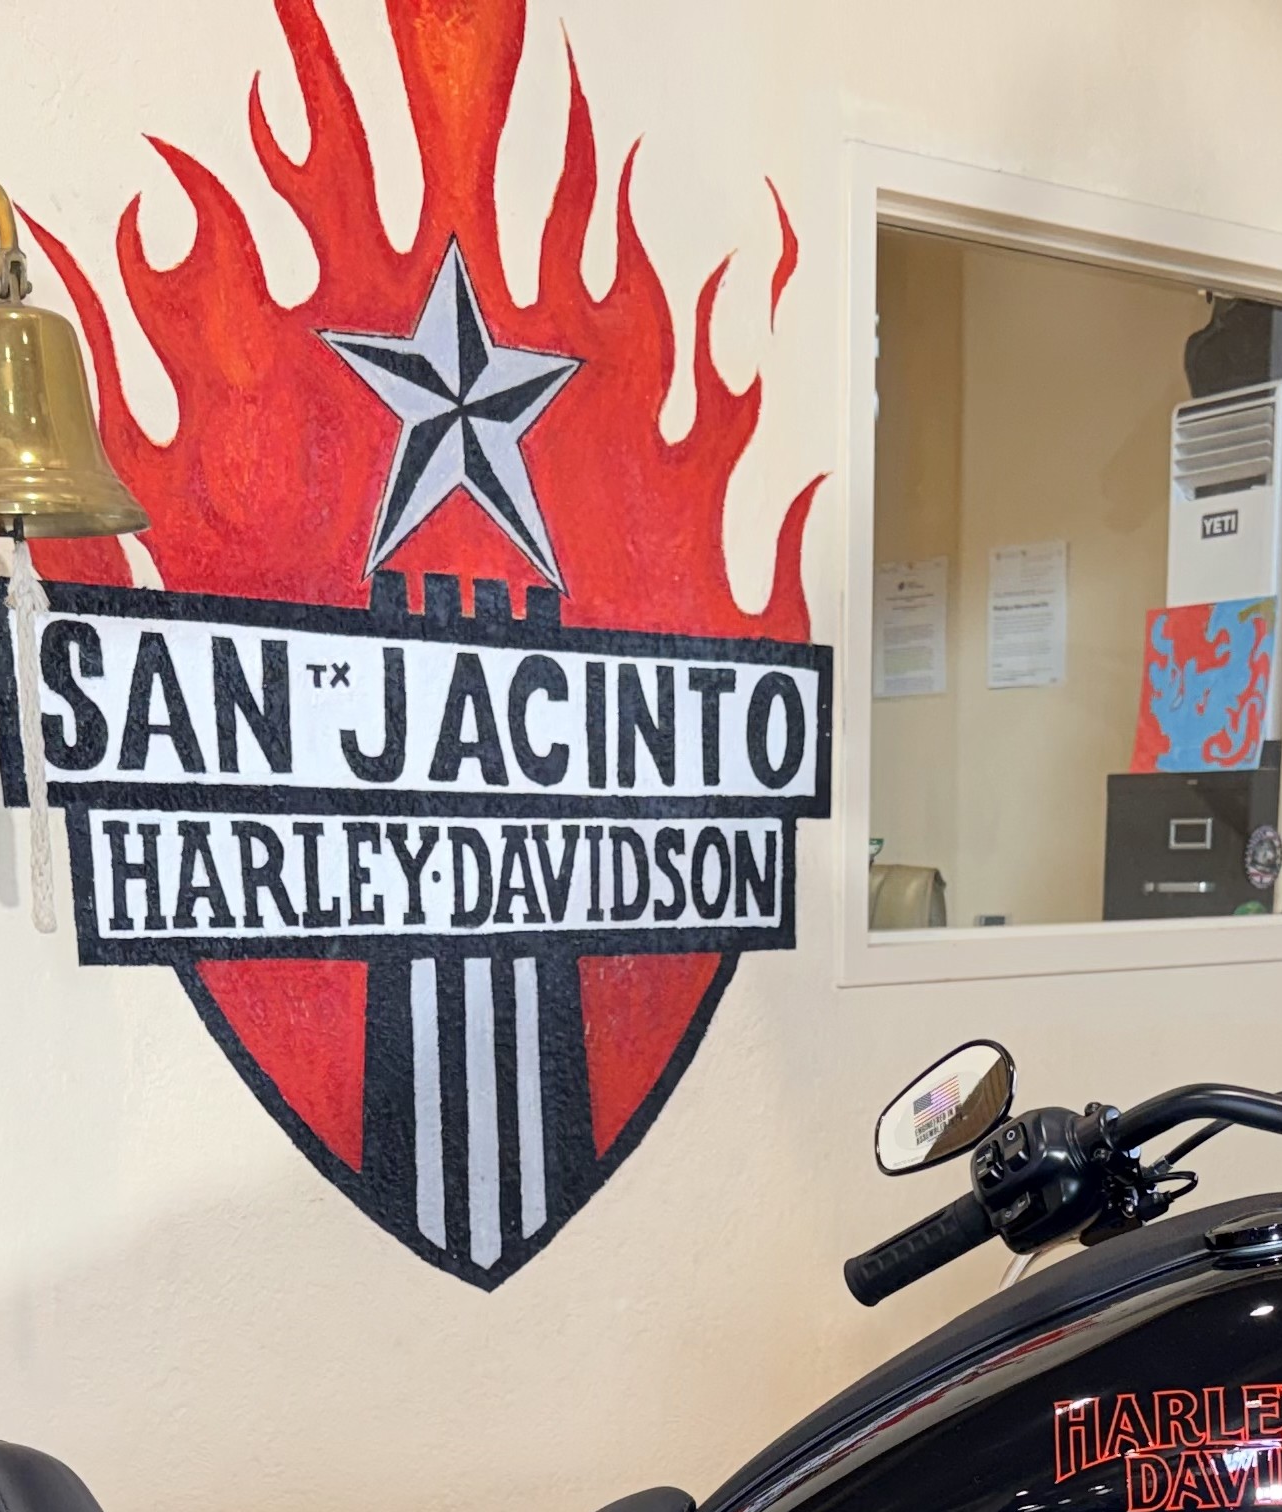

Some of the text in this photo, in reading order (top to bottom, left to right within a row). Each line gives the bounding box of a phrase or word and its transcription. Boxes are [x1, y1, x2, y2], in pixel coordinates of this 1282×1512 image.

[1203, 514, 1236, 535] YETI
[40, 617, 806, 789] SAN TX JACINTO
